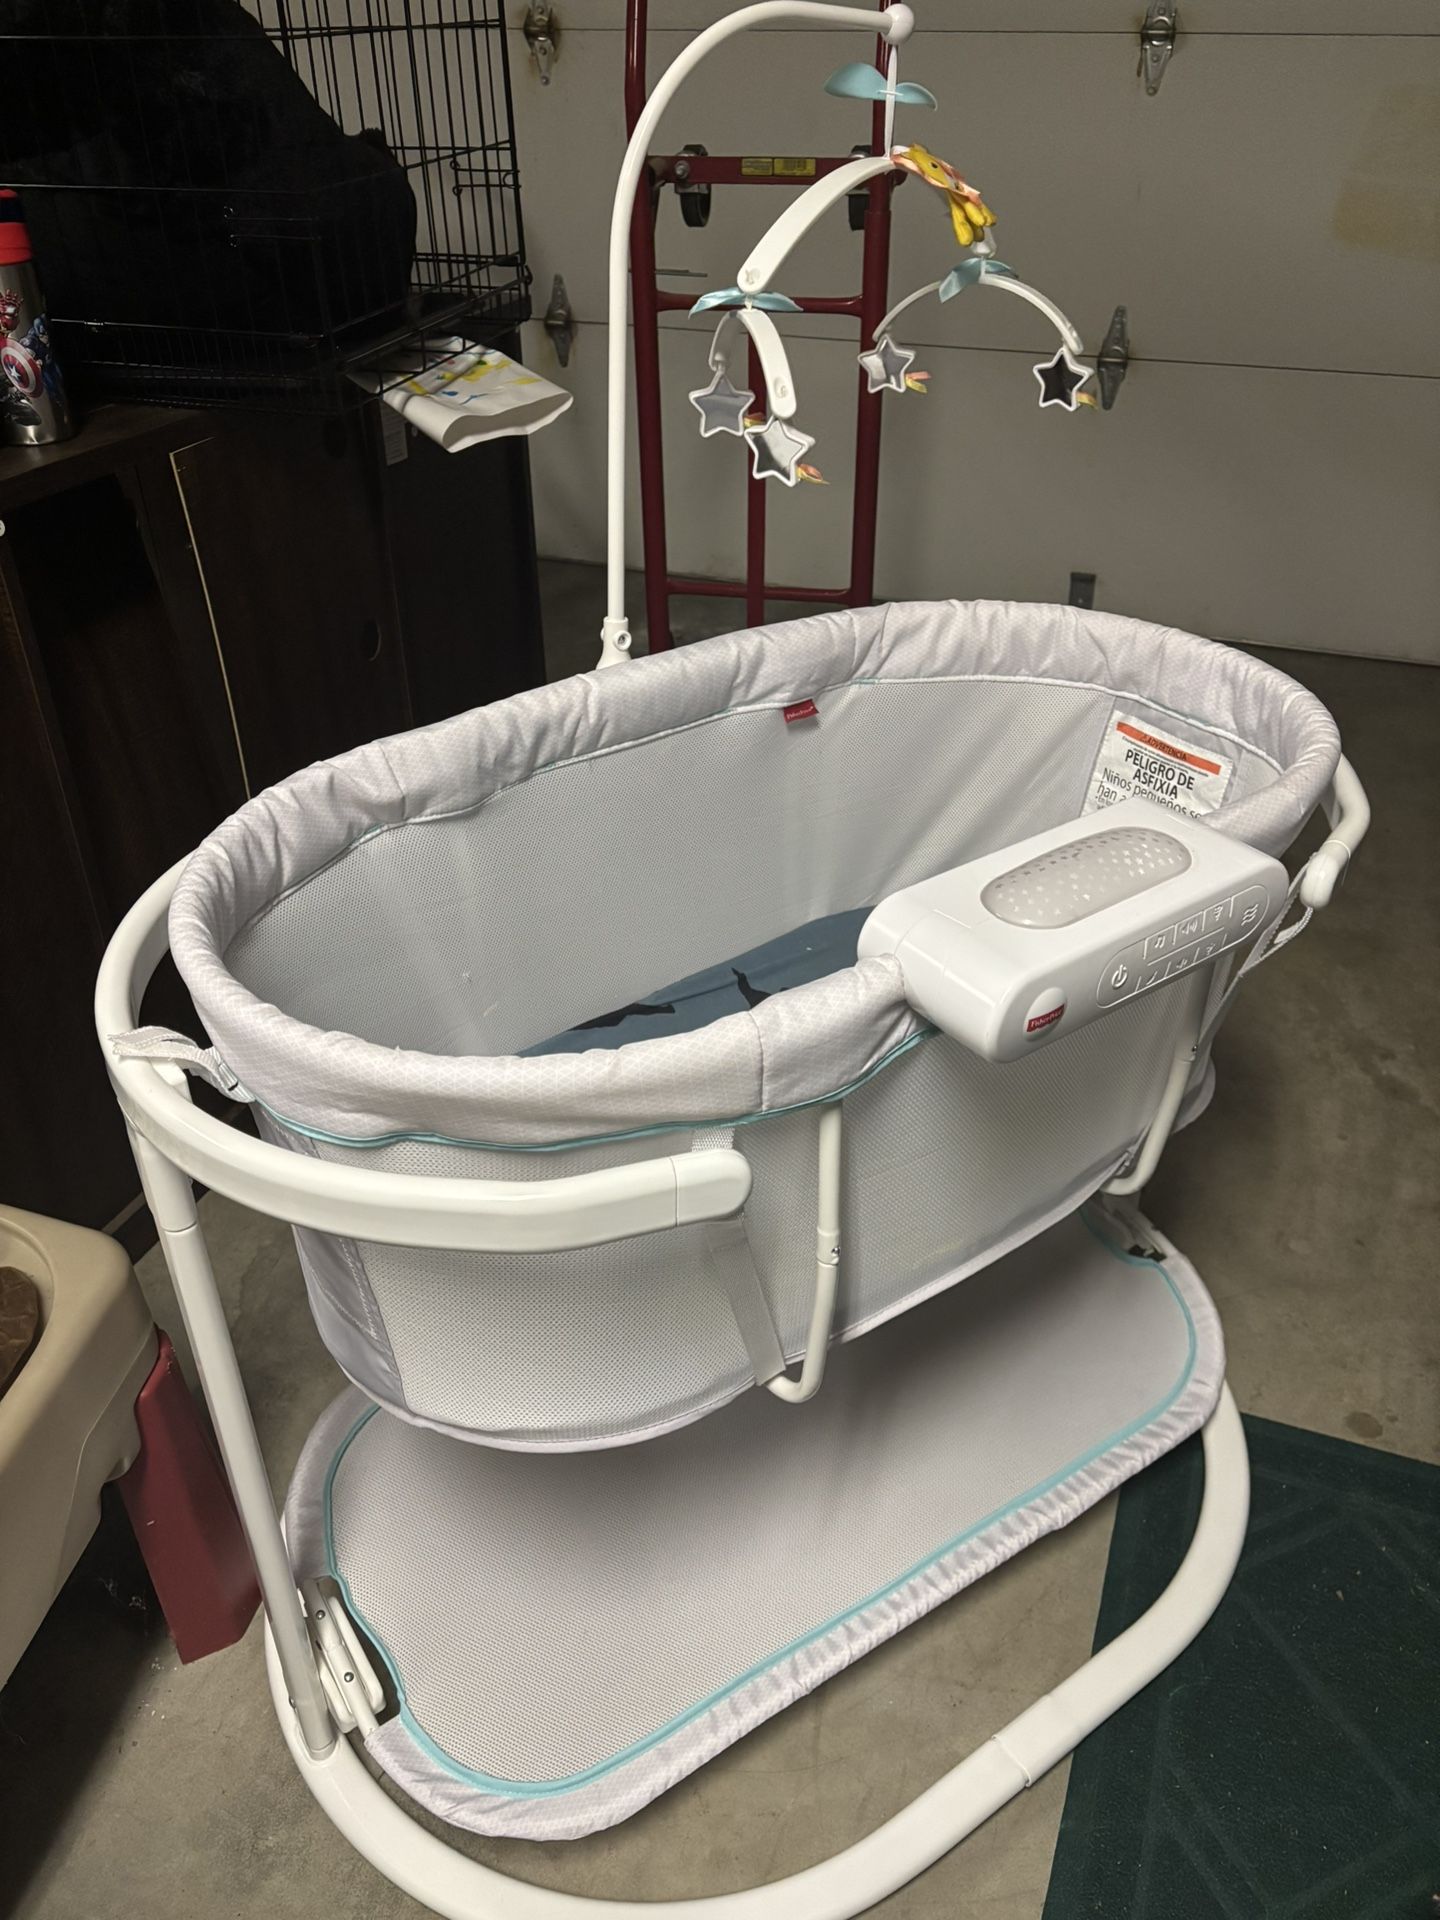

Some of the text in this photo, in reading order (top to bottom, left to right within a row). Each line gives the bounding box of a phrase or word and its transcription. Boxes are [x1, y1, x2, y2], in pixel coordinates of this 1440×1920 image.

[1147, 737, 1187, 761] ADVERTENCIA
[1102, 767, 1132, 792] Niños
[1125, 749, 1176, 781] PELIGRO
[1177, 772, 1195, 791] DE
[1097, 780, 1118, 801] han
[1132, 768, 1178, 799] ASFIXIA
